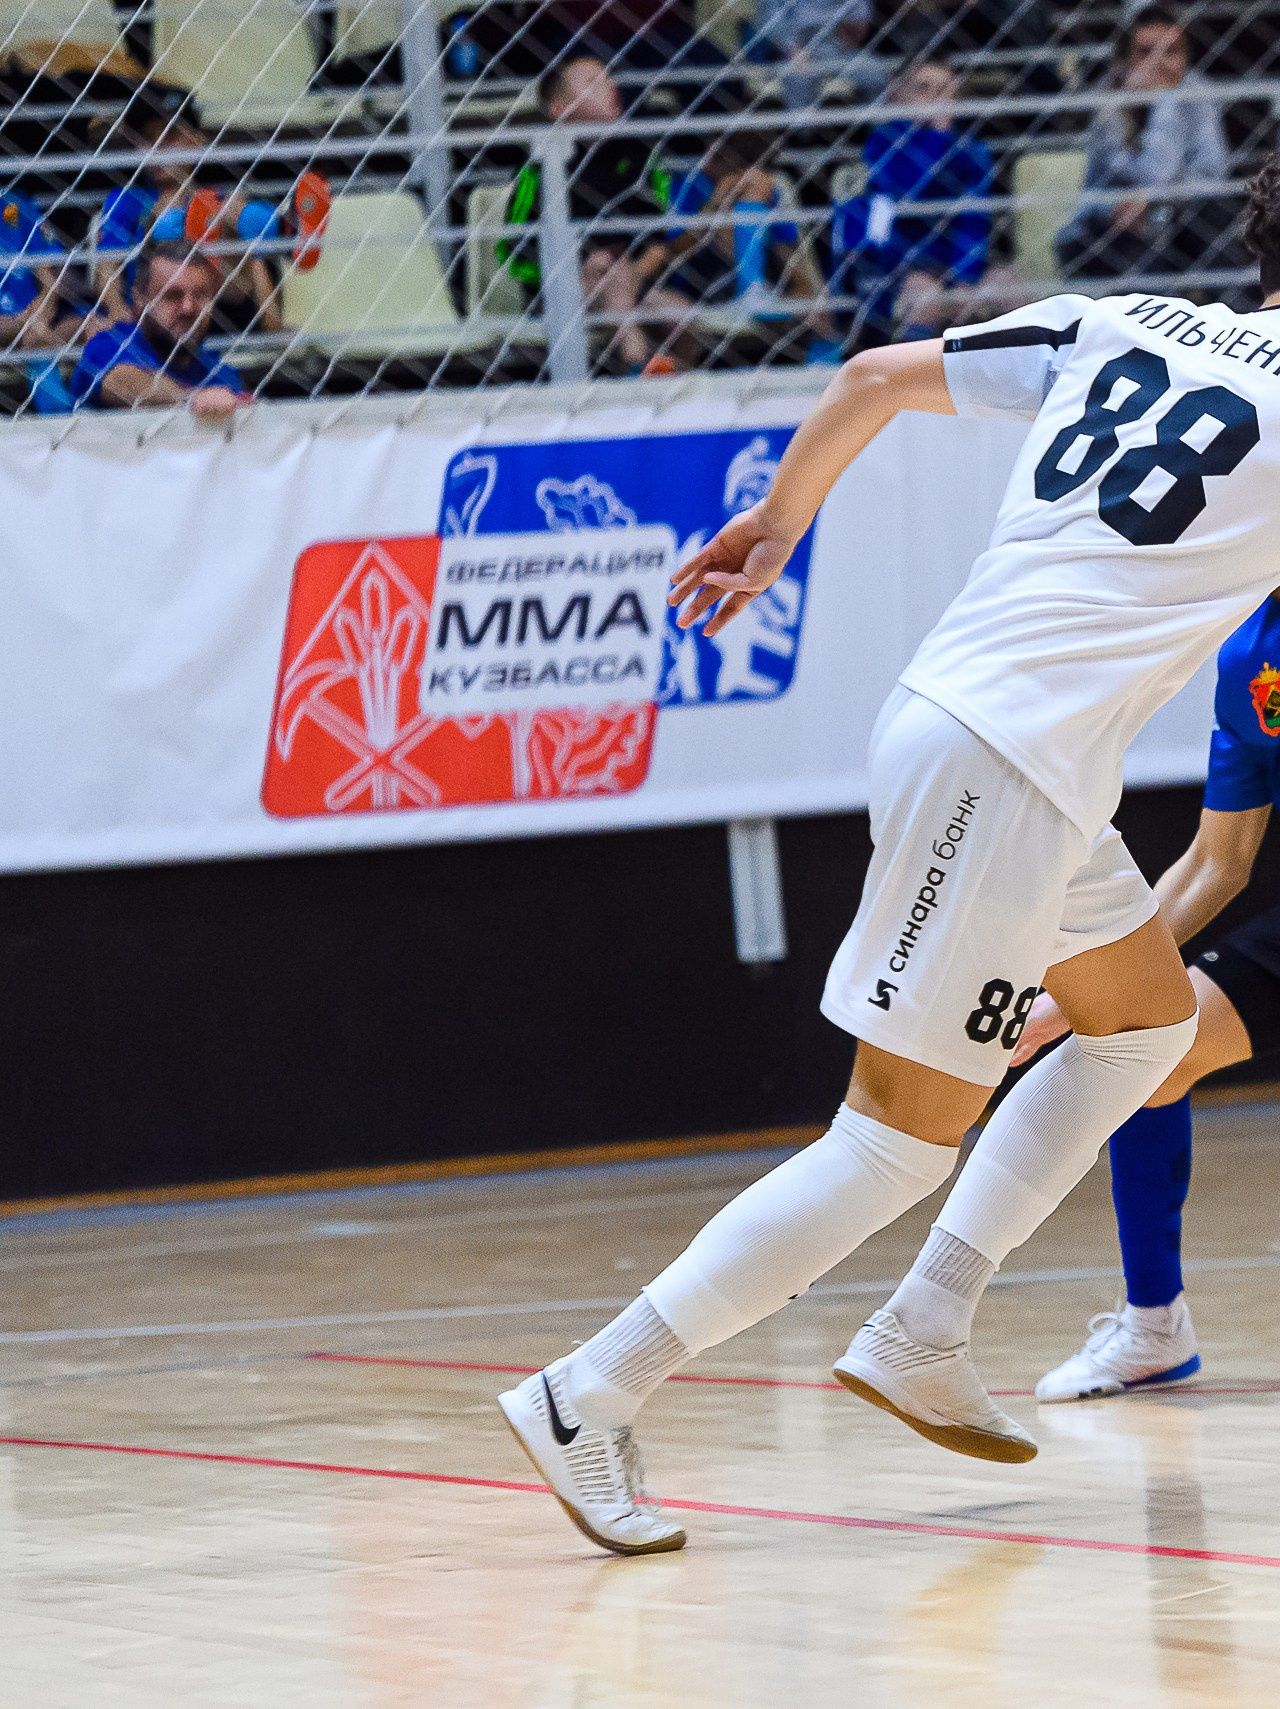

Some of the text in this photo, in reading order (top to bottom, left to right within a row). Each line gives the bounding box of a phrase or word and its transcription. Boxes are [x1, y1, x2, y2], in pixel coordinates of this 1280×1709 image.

[1034, 347, 1261, 546] 88
[447, 548, 667, 584] ФЕДЕРАЦИЯ
[436, 588, 651, 651] ММА
[428, 655, 646, 694] КУЗБАССА
[889, 789, 981, 973] синара банк
[964, 978, 1037, 1050] 88
